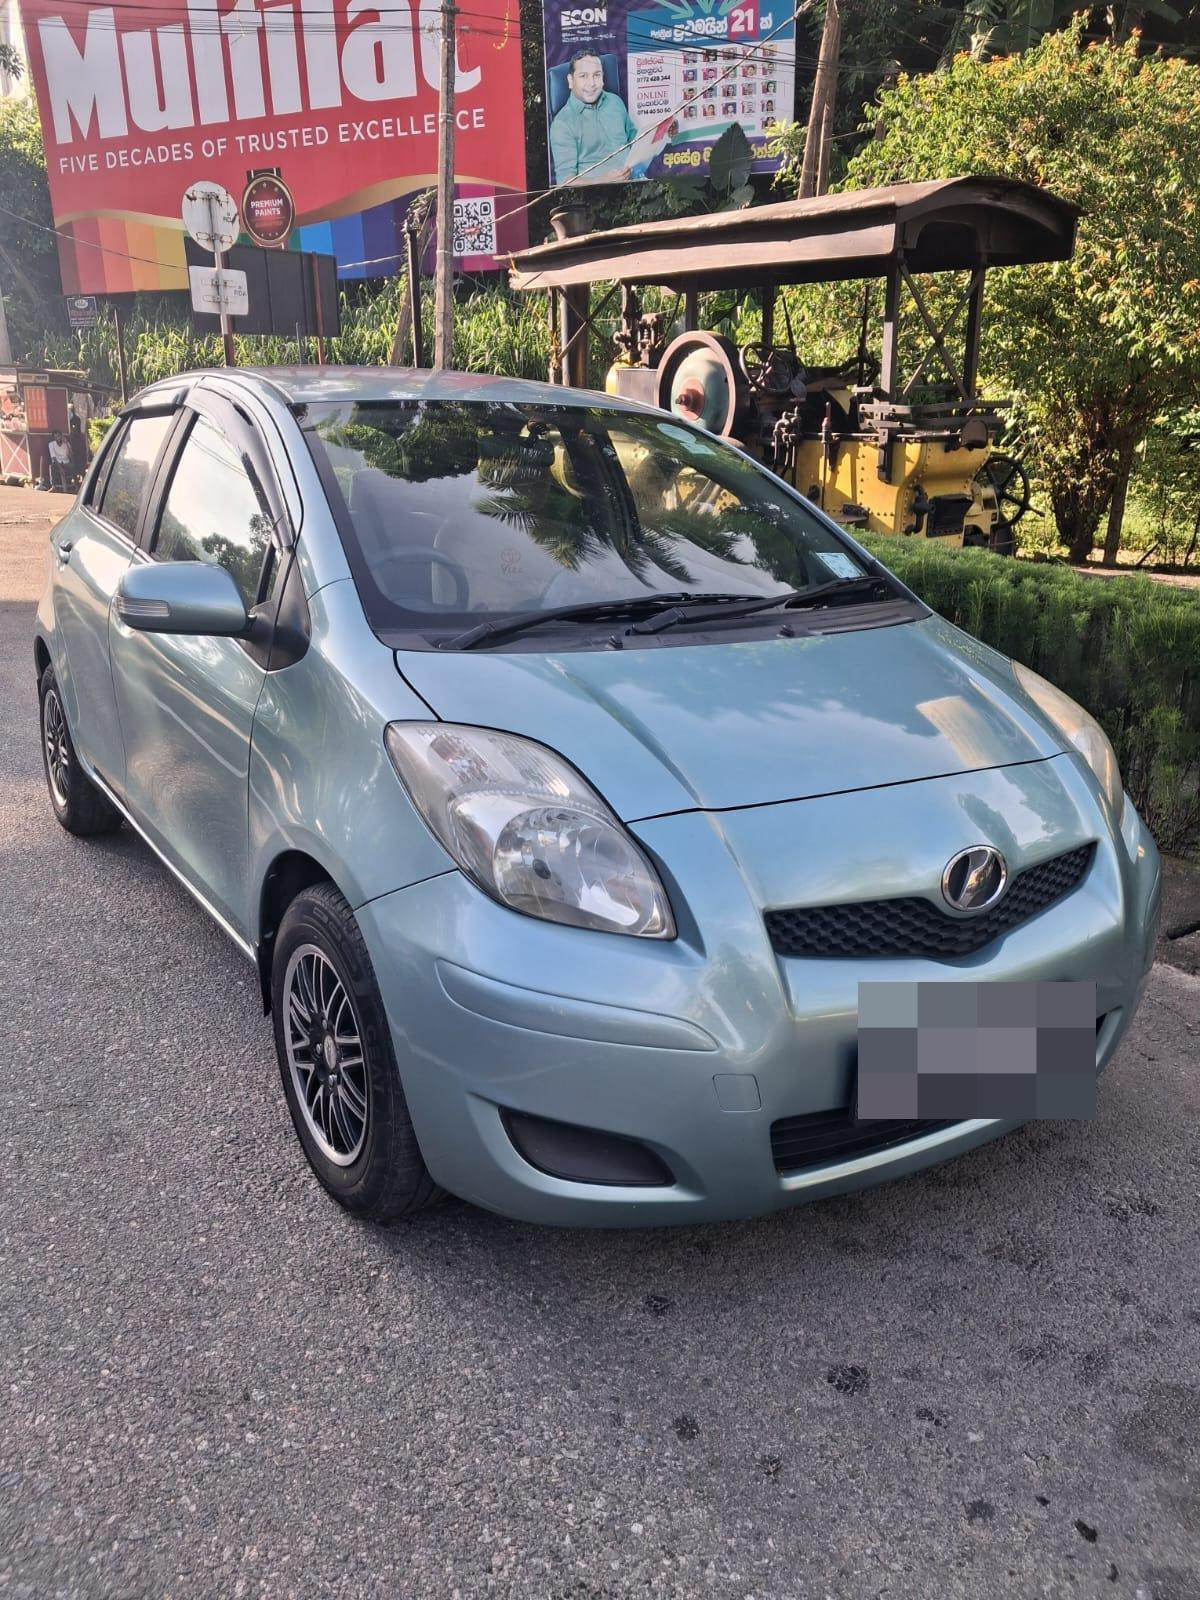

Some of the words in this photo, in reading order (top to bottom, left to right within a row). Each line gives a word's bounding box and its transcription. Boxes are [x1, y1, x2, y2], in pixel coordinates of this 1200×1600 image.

[561, 8, 607, 26] ECON
[731, 8, 754, 32] 21
[38, 0, 482, 144] Multilac
[637, 91, 668, 100] ONLINE
[60, 153, 99, 174] FIVE
[106, 142, 194, 169] DECADES
[202, 138, 227, 157] OF
[235, 127, 329, 153] TRUSTED
[338, 108, 486, 143] EXCELLECE
[250, 199, 284, 208] PREMIUM
[255, 208, 281, 216] PAINTS
